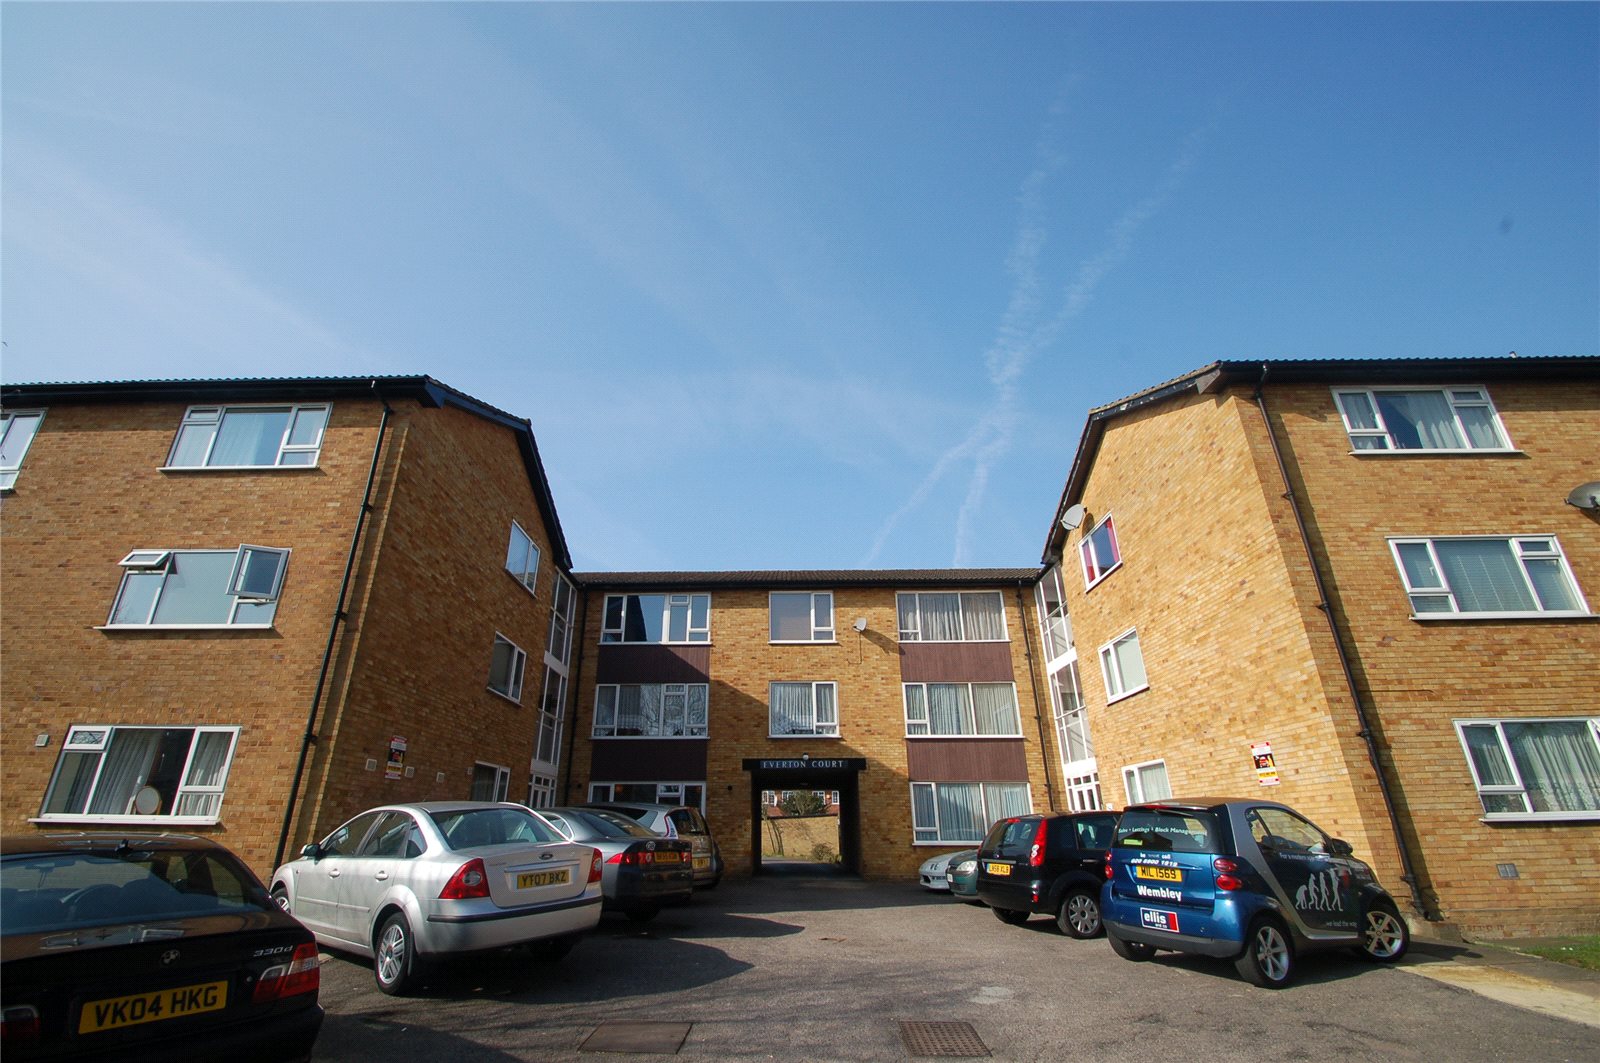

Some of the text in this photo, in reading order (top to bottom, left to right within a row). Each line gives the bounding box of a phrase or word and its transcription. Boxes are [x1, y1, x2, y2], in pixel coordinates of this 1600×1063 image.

[763, 760, 844, 769] EVERTON COURT
[522, 873, 547, 887] YT07
[1140, 867, 1177, 880] MIL 1569
[1136, 885, 1182, 902] Wembley
[1144, 911, 1167, 924] ellis
[254, 945, 294, 957] 330d
[94, 985, 218, 1028] VK04 HKG
